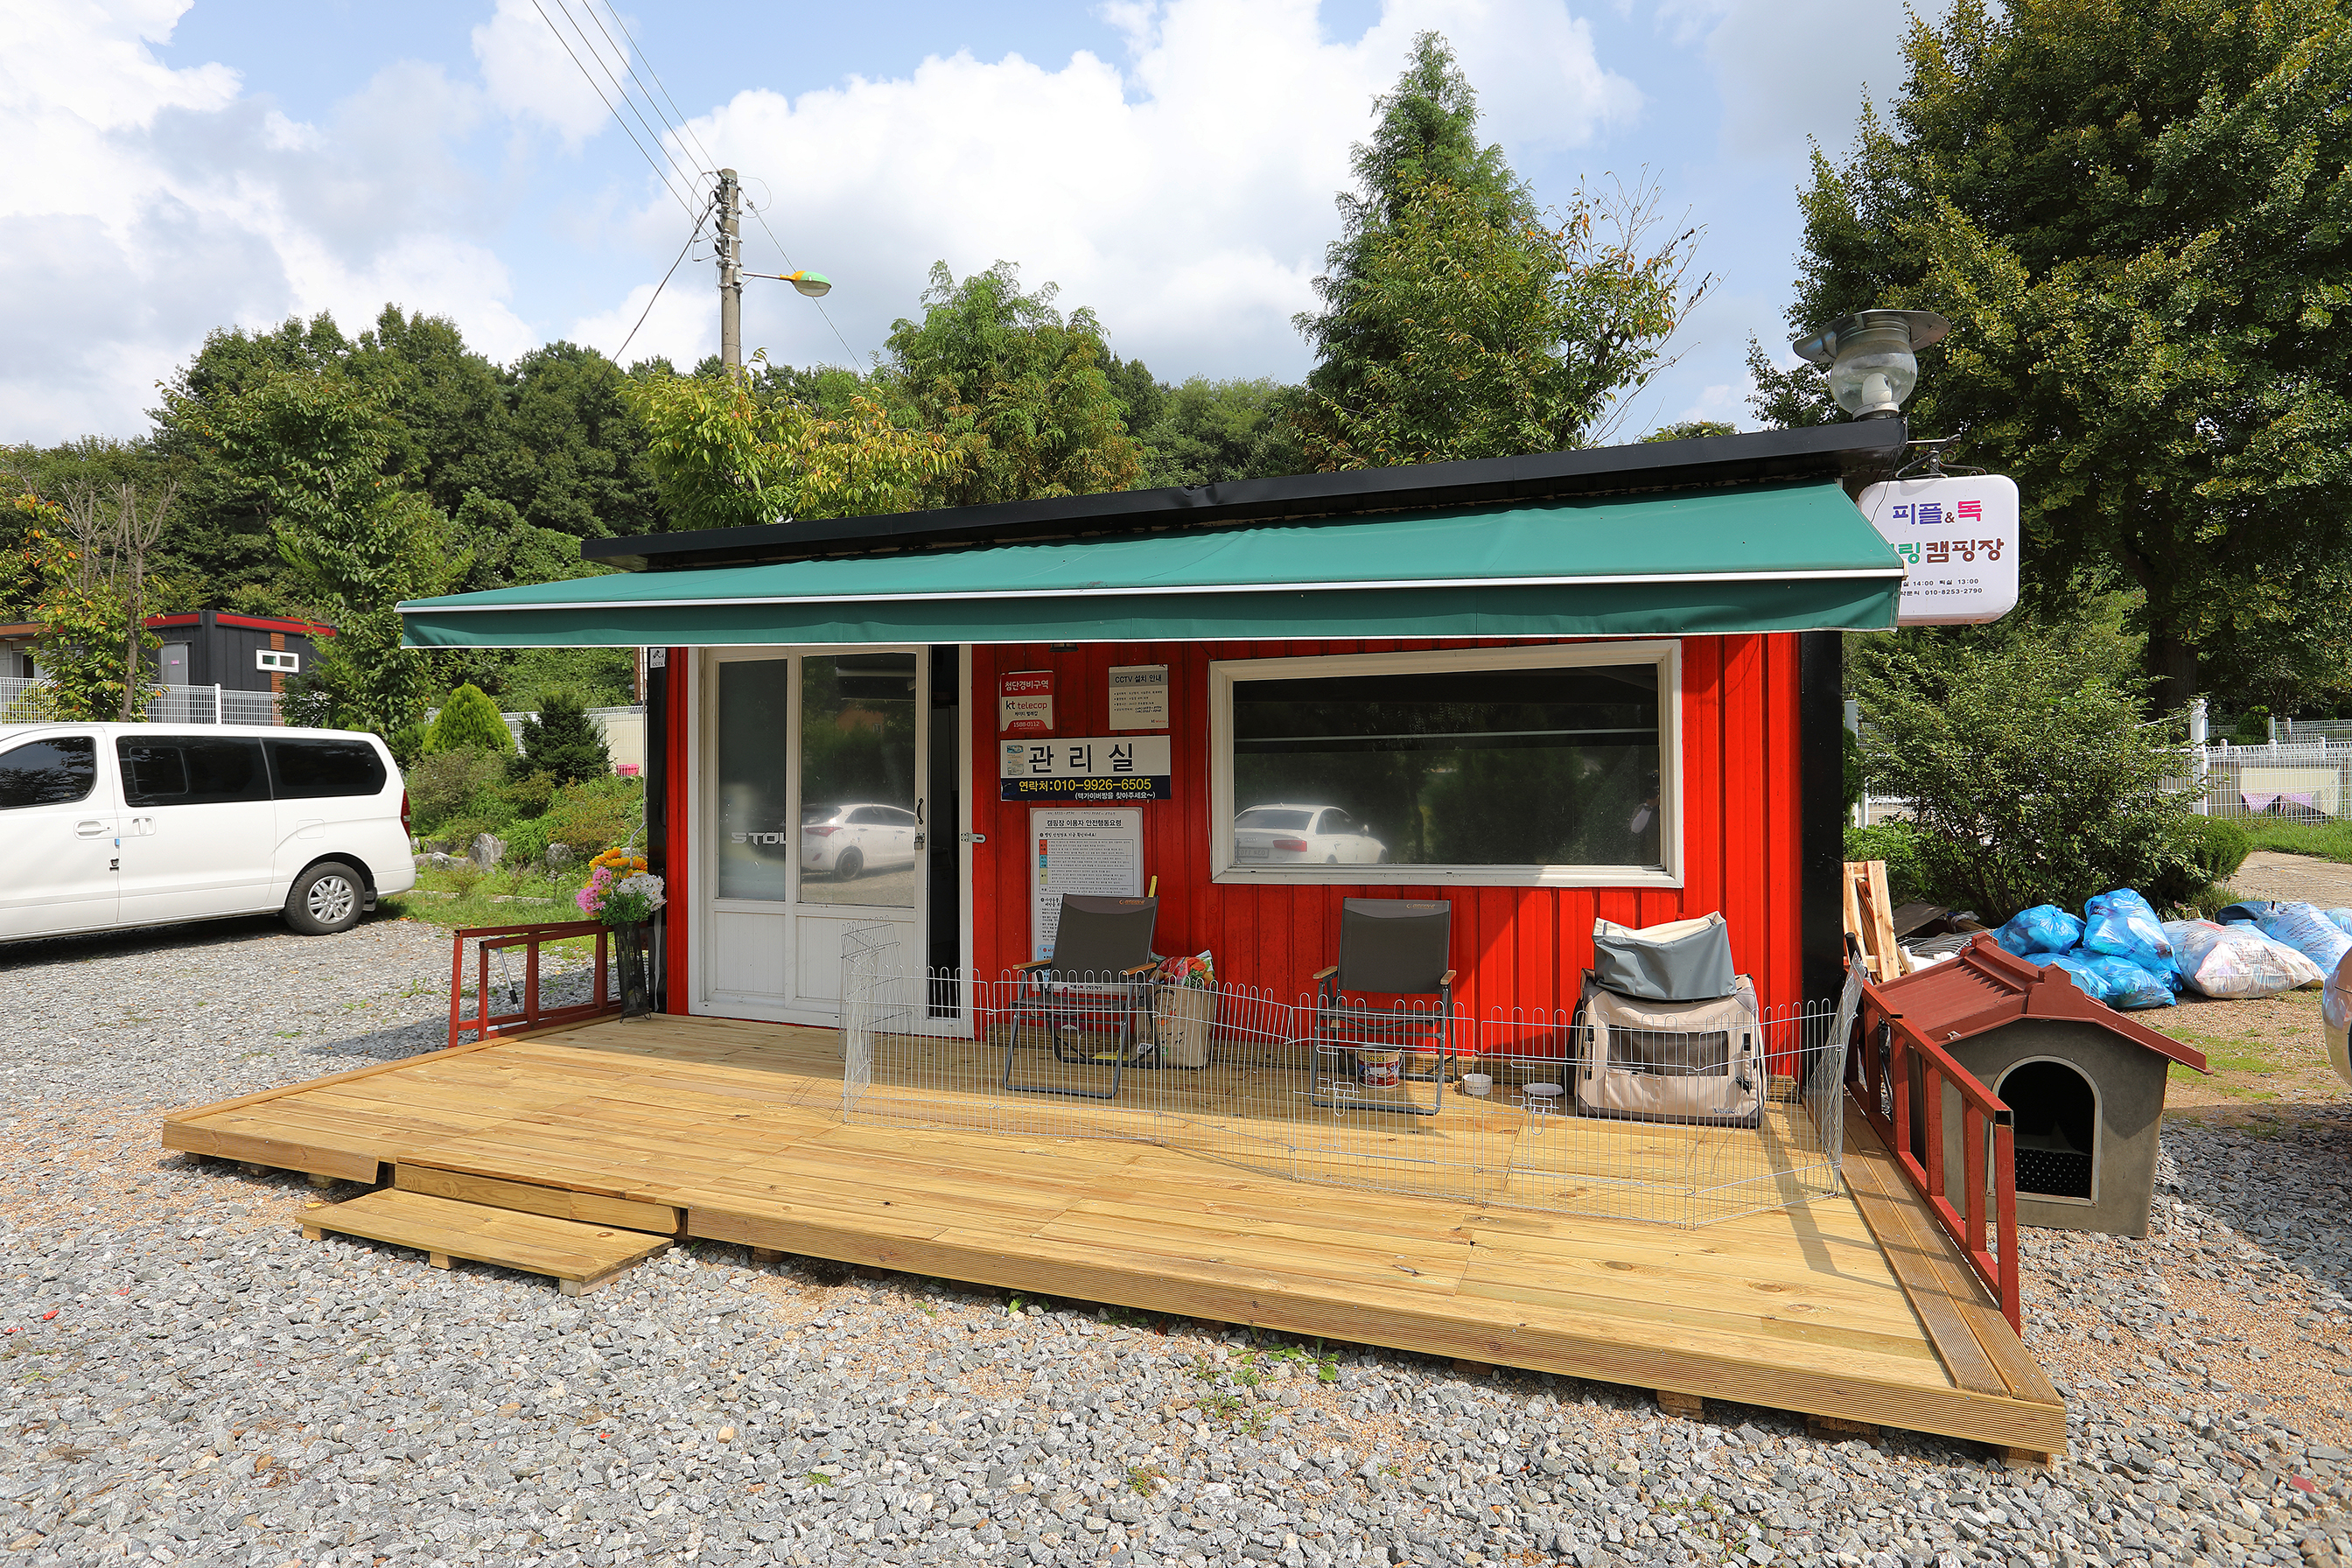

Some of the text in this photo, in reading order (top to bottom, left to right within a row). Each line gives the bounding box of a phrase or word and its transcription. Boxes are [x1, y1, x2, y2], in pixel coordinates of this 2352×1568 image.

[1893, 500, 1983, 525] 피플&독
[1925, 587, 1983, 596] 010-8253-2790
[1149, 674, 1162, 682] 안내
[1004, 679, 1049, 691] 첨단경비구역
[1005, 700, 1048, 710] kt telecop
